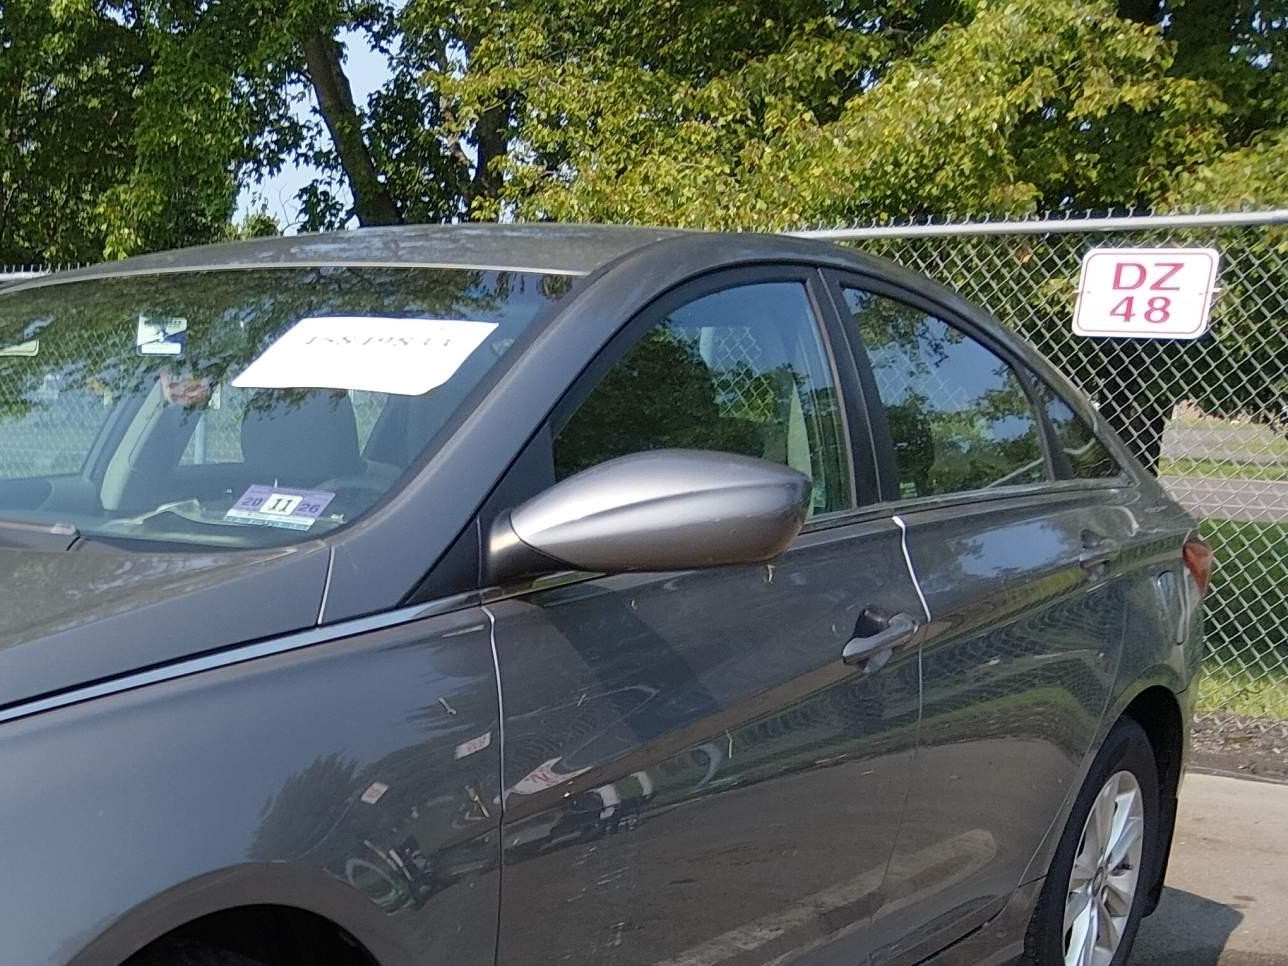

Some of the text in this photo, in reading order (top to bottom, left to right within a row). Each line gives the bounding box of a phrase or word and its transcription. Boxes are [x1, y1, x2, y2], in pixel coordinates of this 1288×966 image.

[1112, 262, 1185, 291] DZ
[1109, 296, 1172, 324] 48
[268, 498, 293, 512] 11
[297, 503, 321, 513] 26
